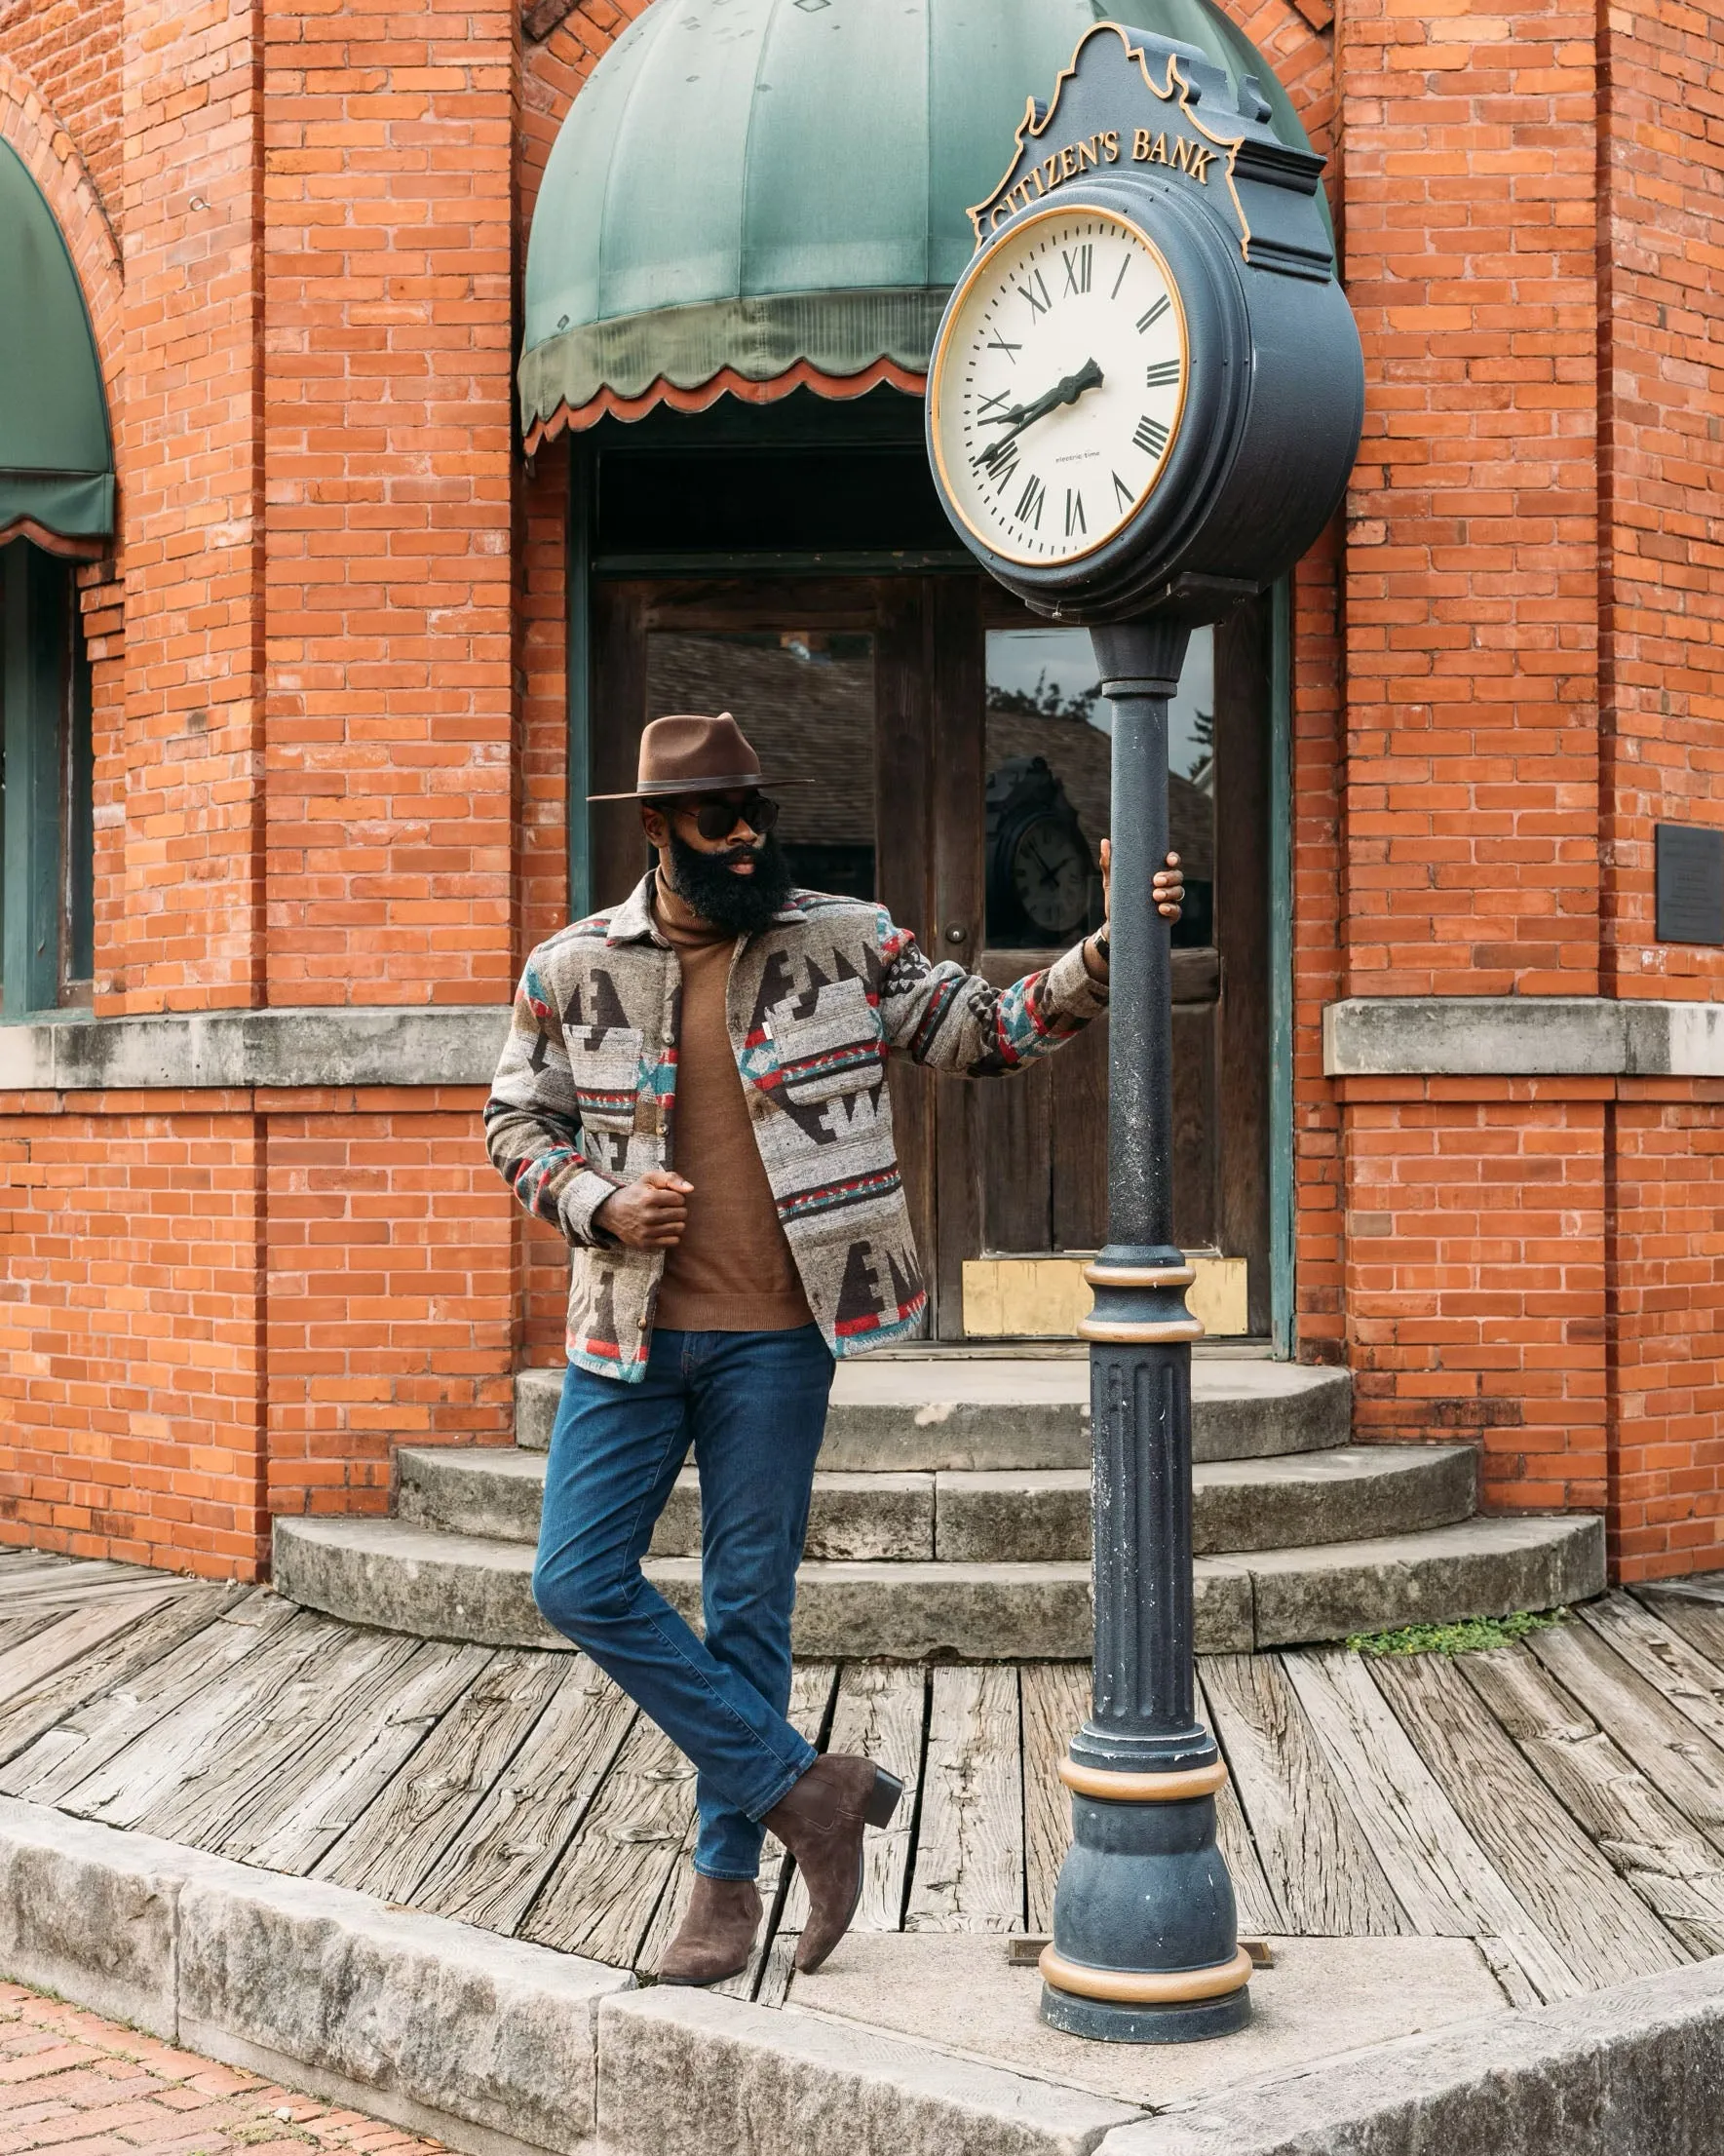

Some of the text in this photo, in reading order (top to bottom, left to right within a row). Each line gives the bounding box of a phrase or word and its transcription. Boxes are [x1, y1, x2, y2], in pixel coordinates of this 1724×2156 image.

[990, 129, 1218, 231] CITIZEN'S BANK
[1062, 244, 1092, 299] XII
[1017, 269, 1053, 326] XI
[1135, 293, 1171, 334] II
[987, 328, 1022, 365] X
[1147, 359, 1180, 388] III
[985, 440, 1020, 496] VII
[1055, 453, 1083, 463] electric
[1015, 474, 1046, 530] VII
[1065, 488, 1087, 536] VI
